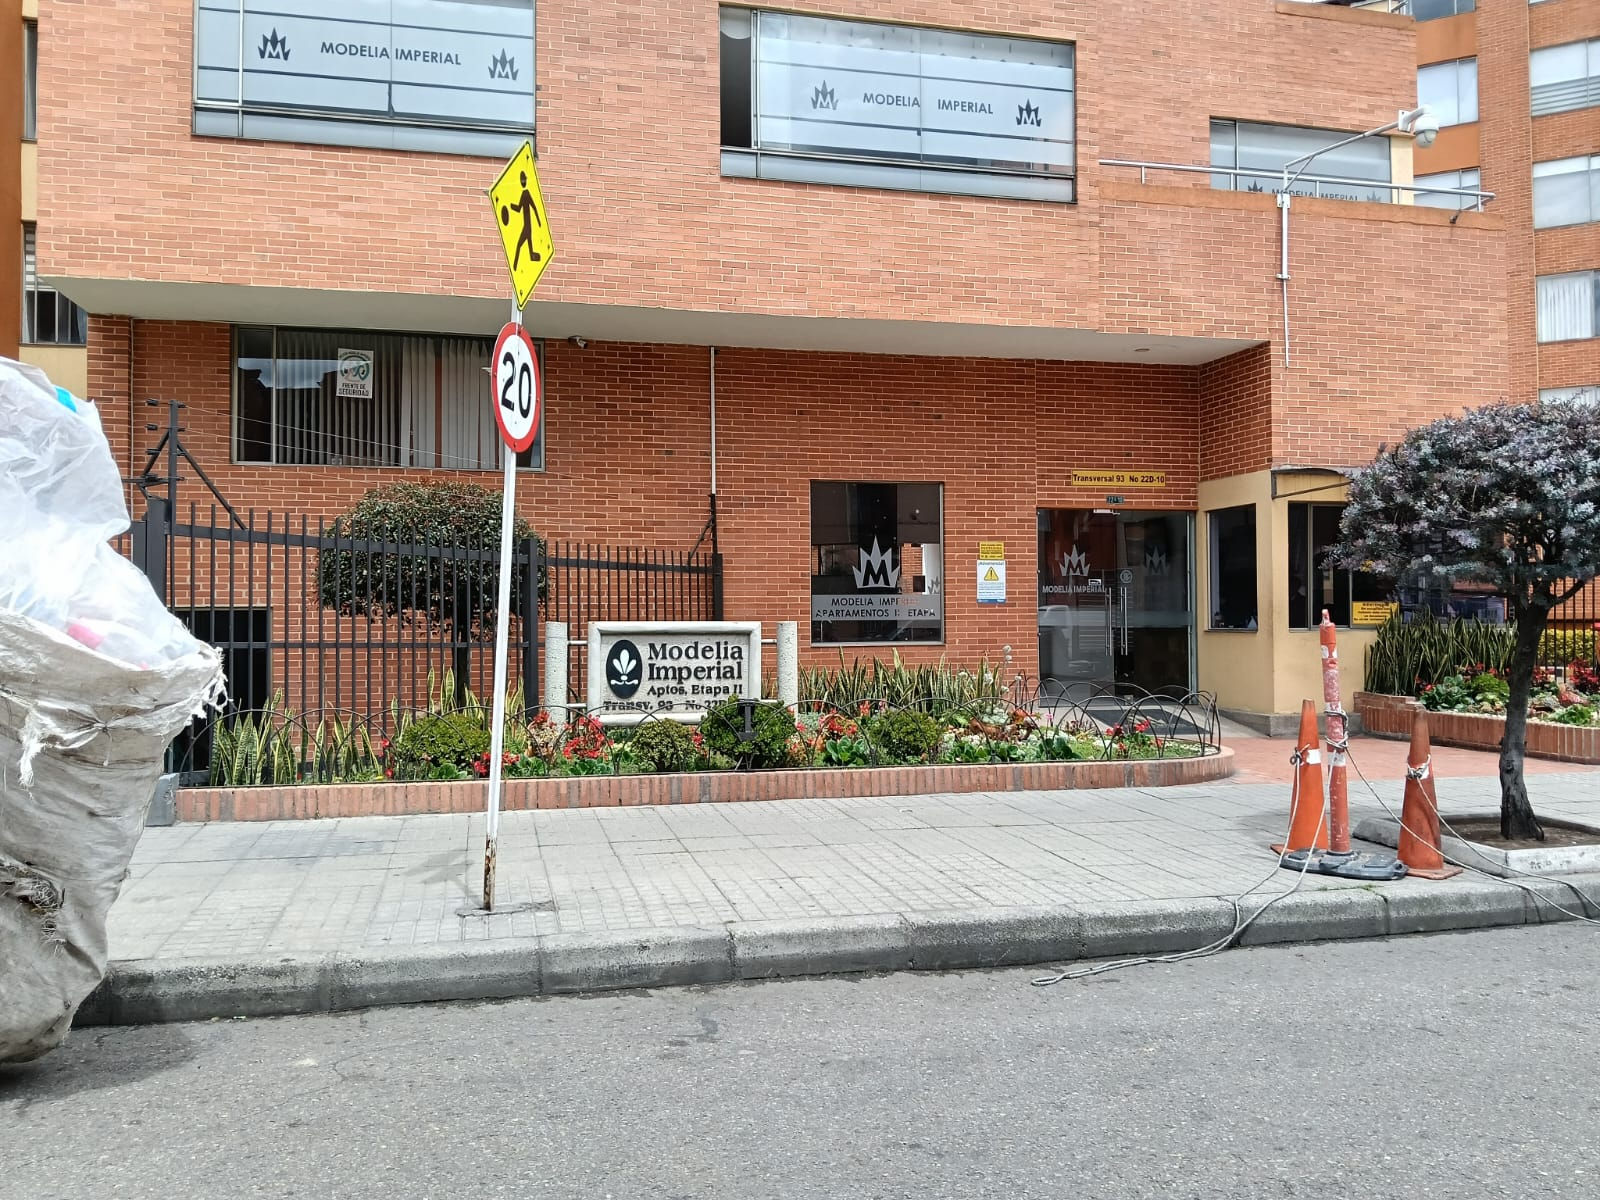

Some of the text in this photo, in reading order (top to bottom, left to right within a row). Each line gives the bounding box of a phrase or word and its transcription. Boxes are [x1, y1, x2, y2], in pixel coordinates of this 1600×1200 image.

[320, 41, 462, 66] MODELIA IMPERIAL
[862, 92, 994, 115] MODELIA IMPERIAL
[1272, 188, 1314, 198] MDELIA
[501, 351, 531, 419] 20
[1073, 474, 1115, 483] Transversal
[1116, 475, 1125, 483] 93
[1129, 475, 1138, 483] No
[1042, 585, 1106, 593] MODELIA IMPERIAL
[831, 598, 874, 606] MODELIA
[815, 609, 889, 618] APARTAMENTOS
[908, 609, 936, 617] ETAPA
[647, 641, 743, 661] Modelia
[647, 661, 743, 684] Imperial
[691, 684, 730, 698] Etapa
[733, 684, 743, 695] II
[603, 700, 653, 711] Transv.
[657, 700, 674, 711] 93
